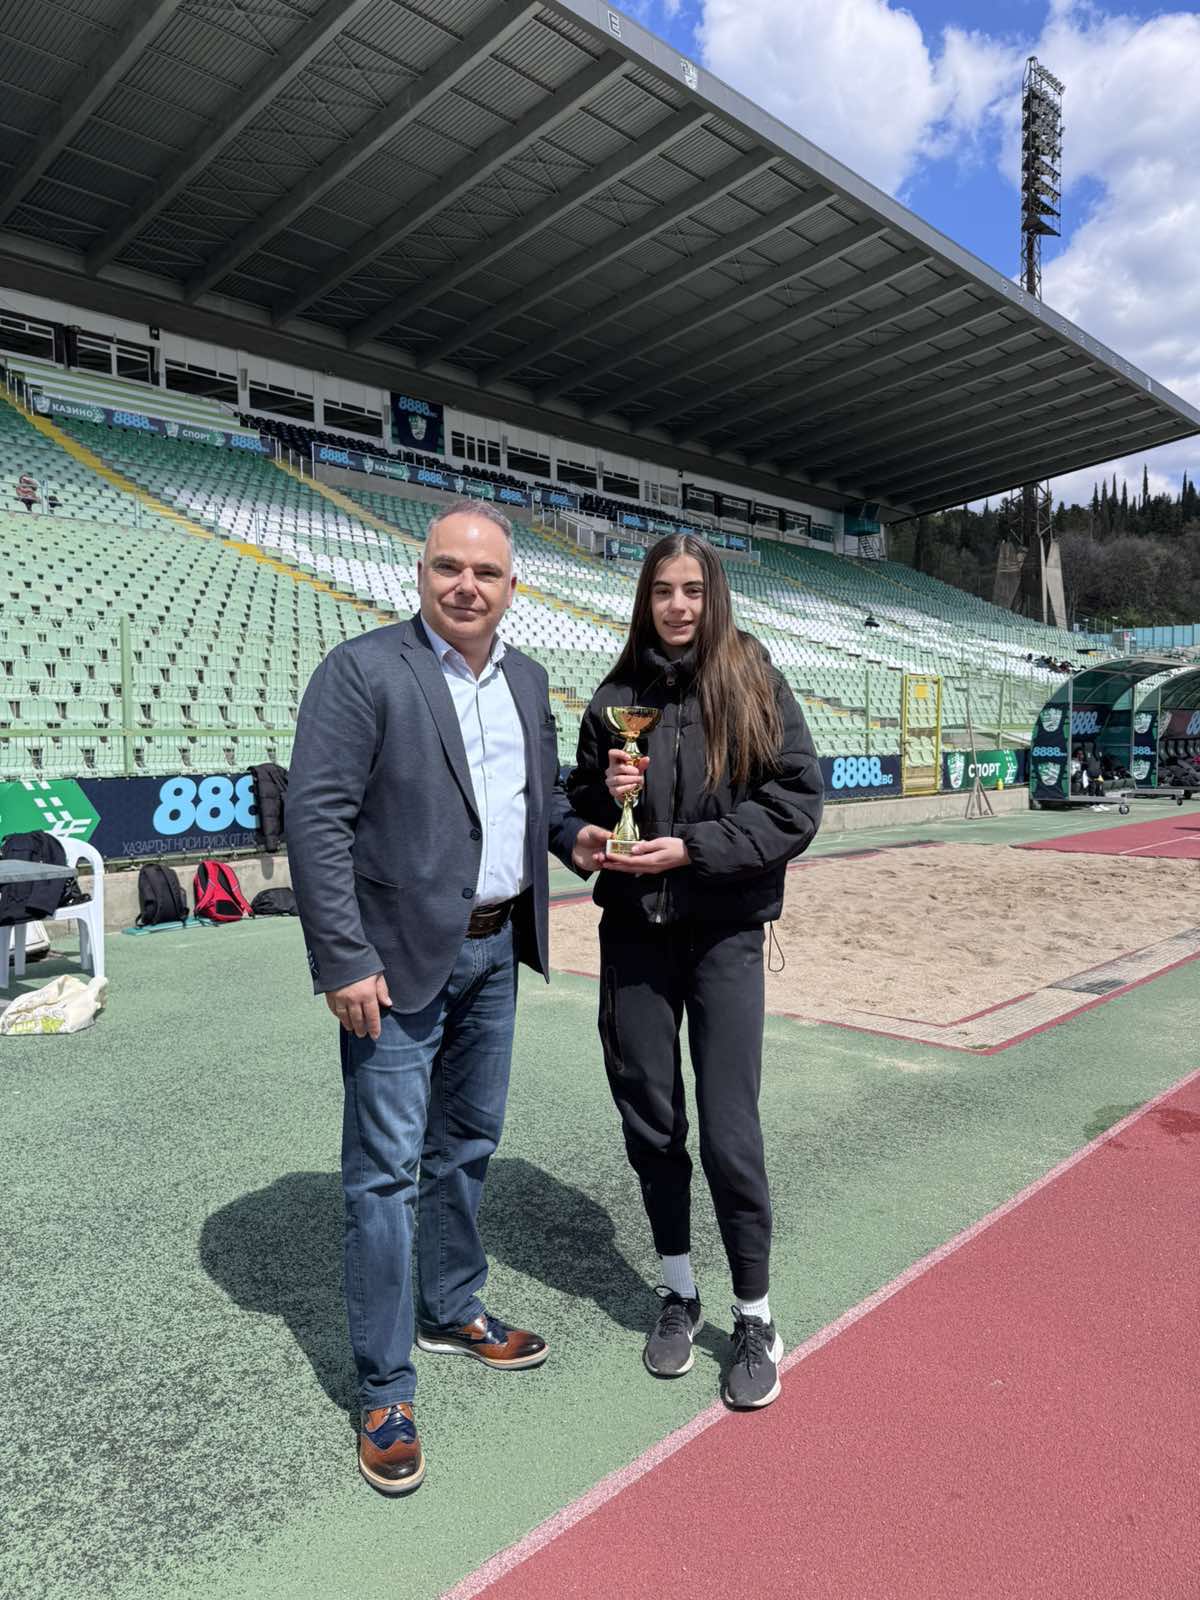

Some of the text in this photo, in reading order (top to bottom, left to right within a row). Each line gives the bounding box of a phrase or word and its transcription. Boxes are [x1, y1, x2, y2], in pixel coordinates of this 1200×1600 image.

[52, 403, 93, 418] КАЗИНО
[182, 429, 209, 441] СПОРТ
[831, 756, 893, 789] 8888.BG
[968, 762, 1001, 778] СПОРТ
